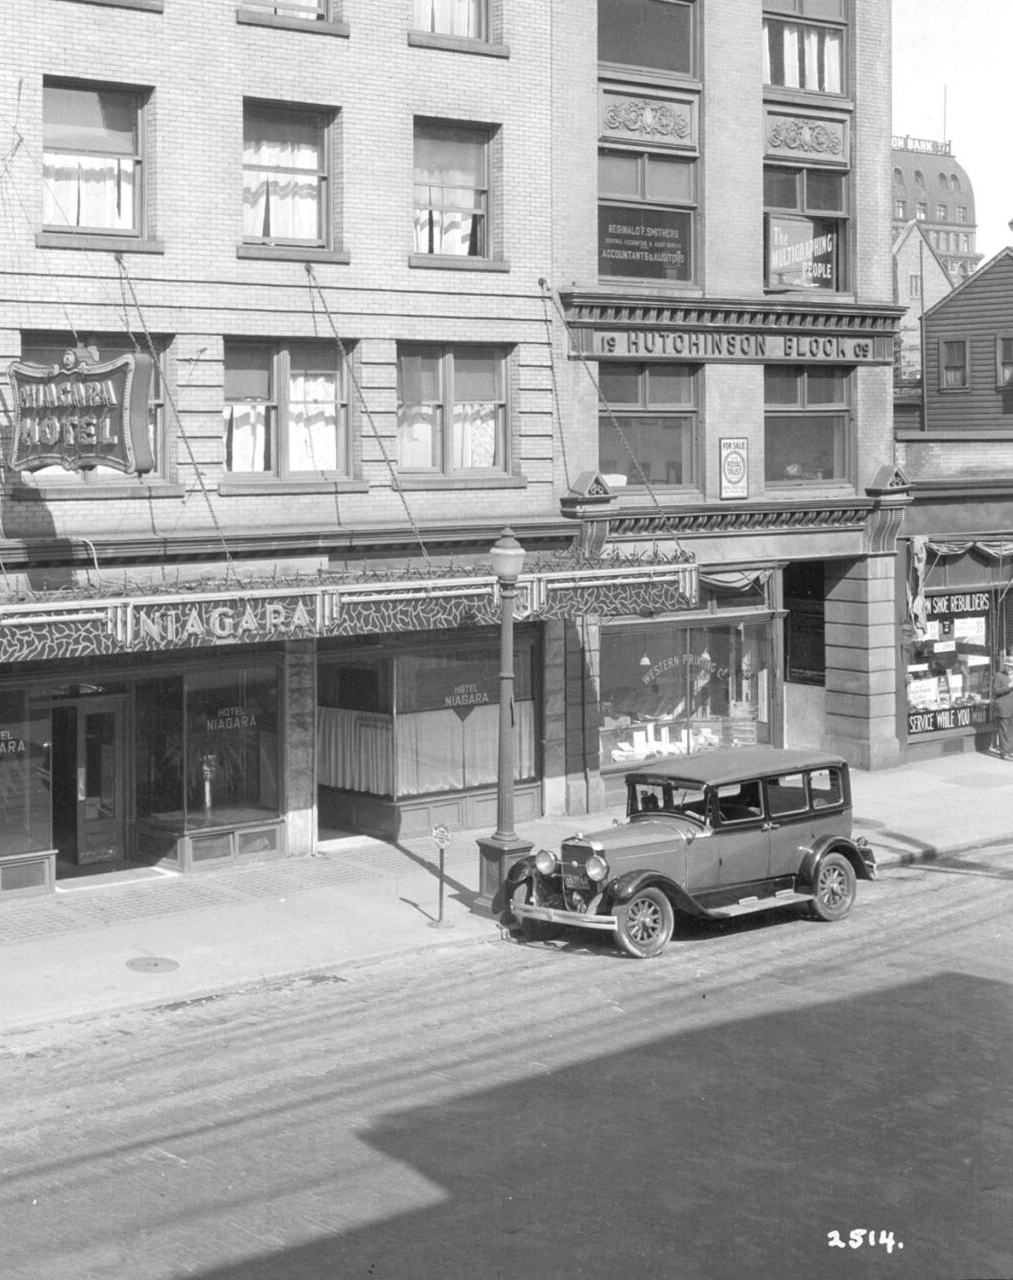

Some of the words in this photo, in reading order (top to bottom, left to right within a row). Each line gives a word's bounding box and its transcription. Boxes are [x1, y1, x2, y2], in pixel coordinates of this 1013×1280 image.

[907, 139, 933, 152] BANK
[773, 227, 788, 246] The
[602, 249, 649, 261] ACCOUNTANTS
[653, 253, 685, 264] AUDITORS
[771, 233, 833, 270] MULTIGRAPHING
[802, 261, 832, 279] PEOPLE
[601, 335, 616, 352] 19
[627, 330, 767, 357] HUTCHINSON
[783, 335, 846, 358] BLOCK
[853, 339, 869, 358] 09
[20, 380, 118, 408] NIAGARA
[21, 415, 119, 446] HOTEL
[723, 441, 732, 450] FOR
[733, 441, 745, 450] SALE
[932, 595, 950, 614] SHOE
[950, 593, 990, 613] REBUILDERS
[139, 598, 312, 643] NIAGARA
[642, 655, 679, 685] WESTERN
[682, 654, 717, 673] PRINTING
[454, 683, 479, 694] HOTEL
[445, 692, 490, 707] NIAGARA
[218, 706, 246, 718] HOTEL
[909, 713, 934, 733] SERVICE
[936, 709, 955, 729] WHILE
[957, 707, 970, 726] YOU
[207, 715, 257, 732] NIAGARA
